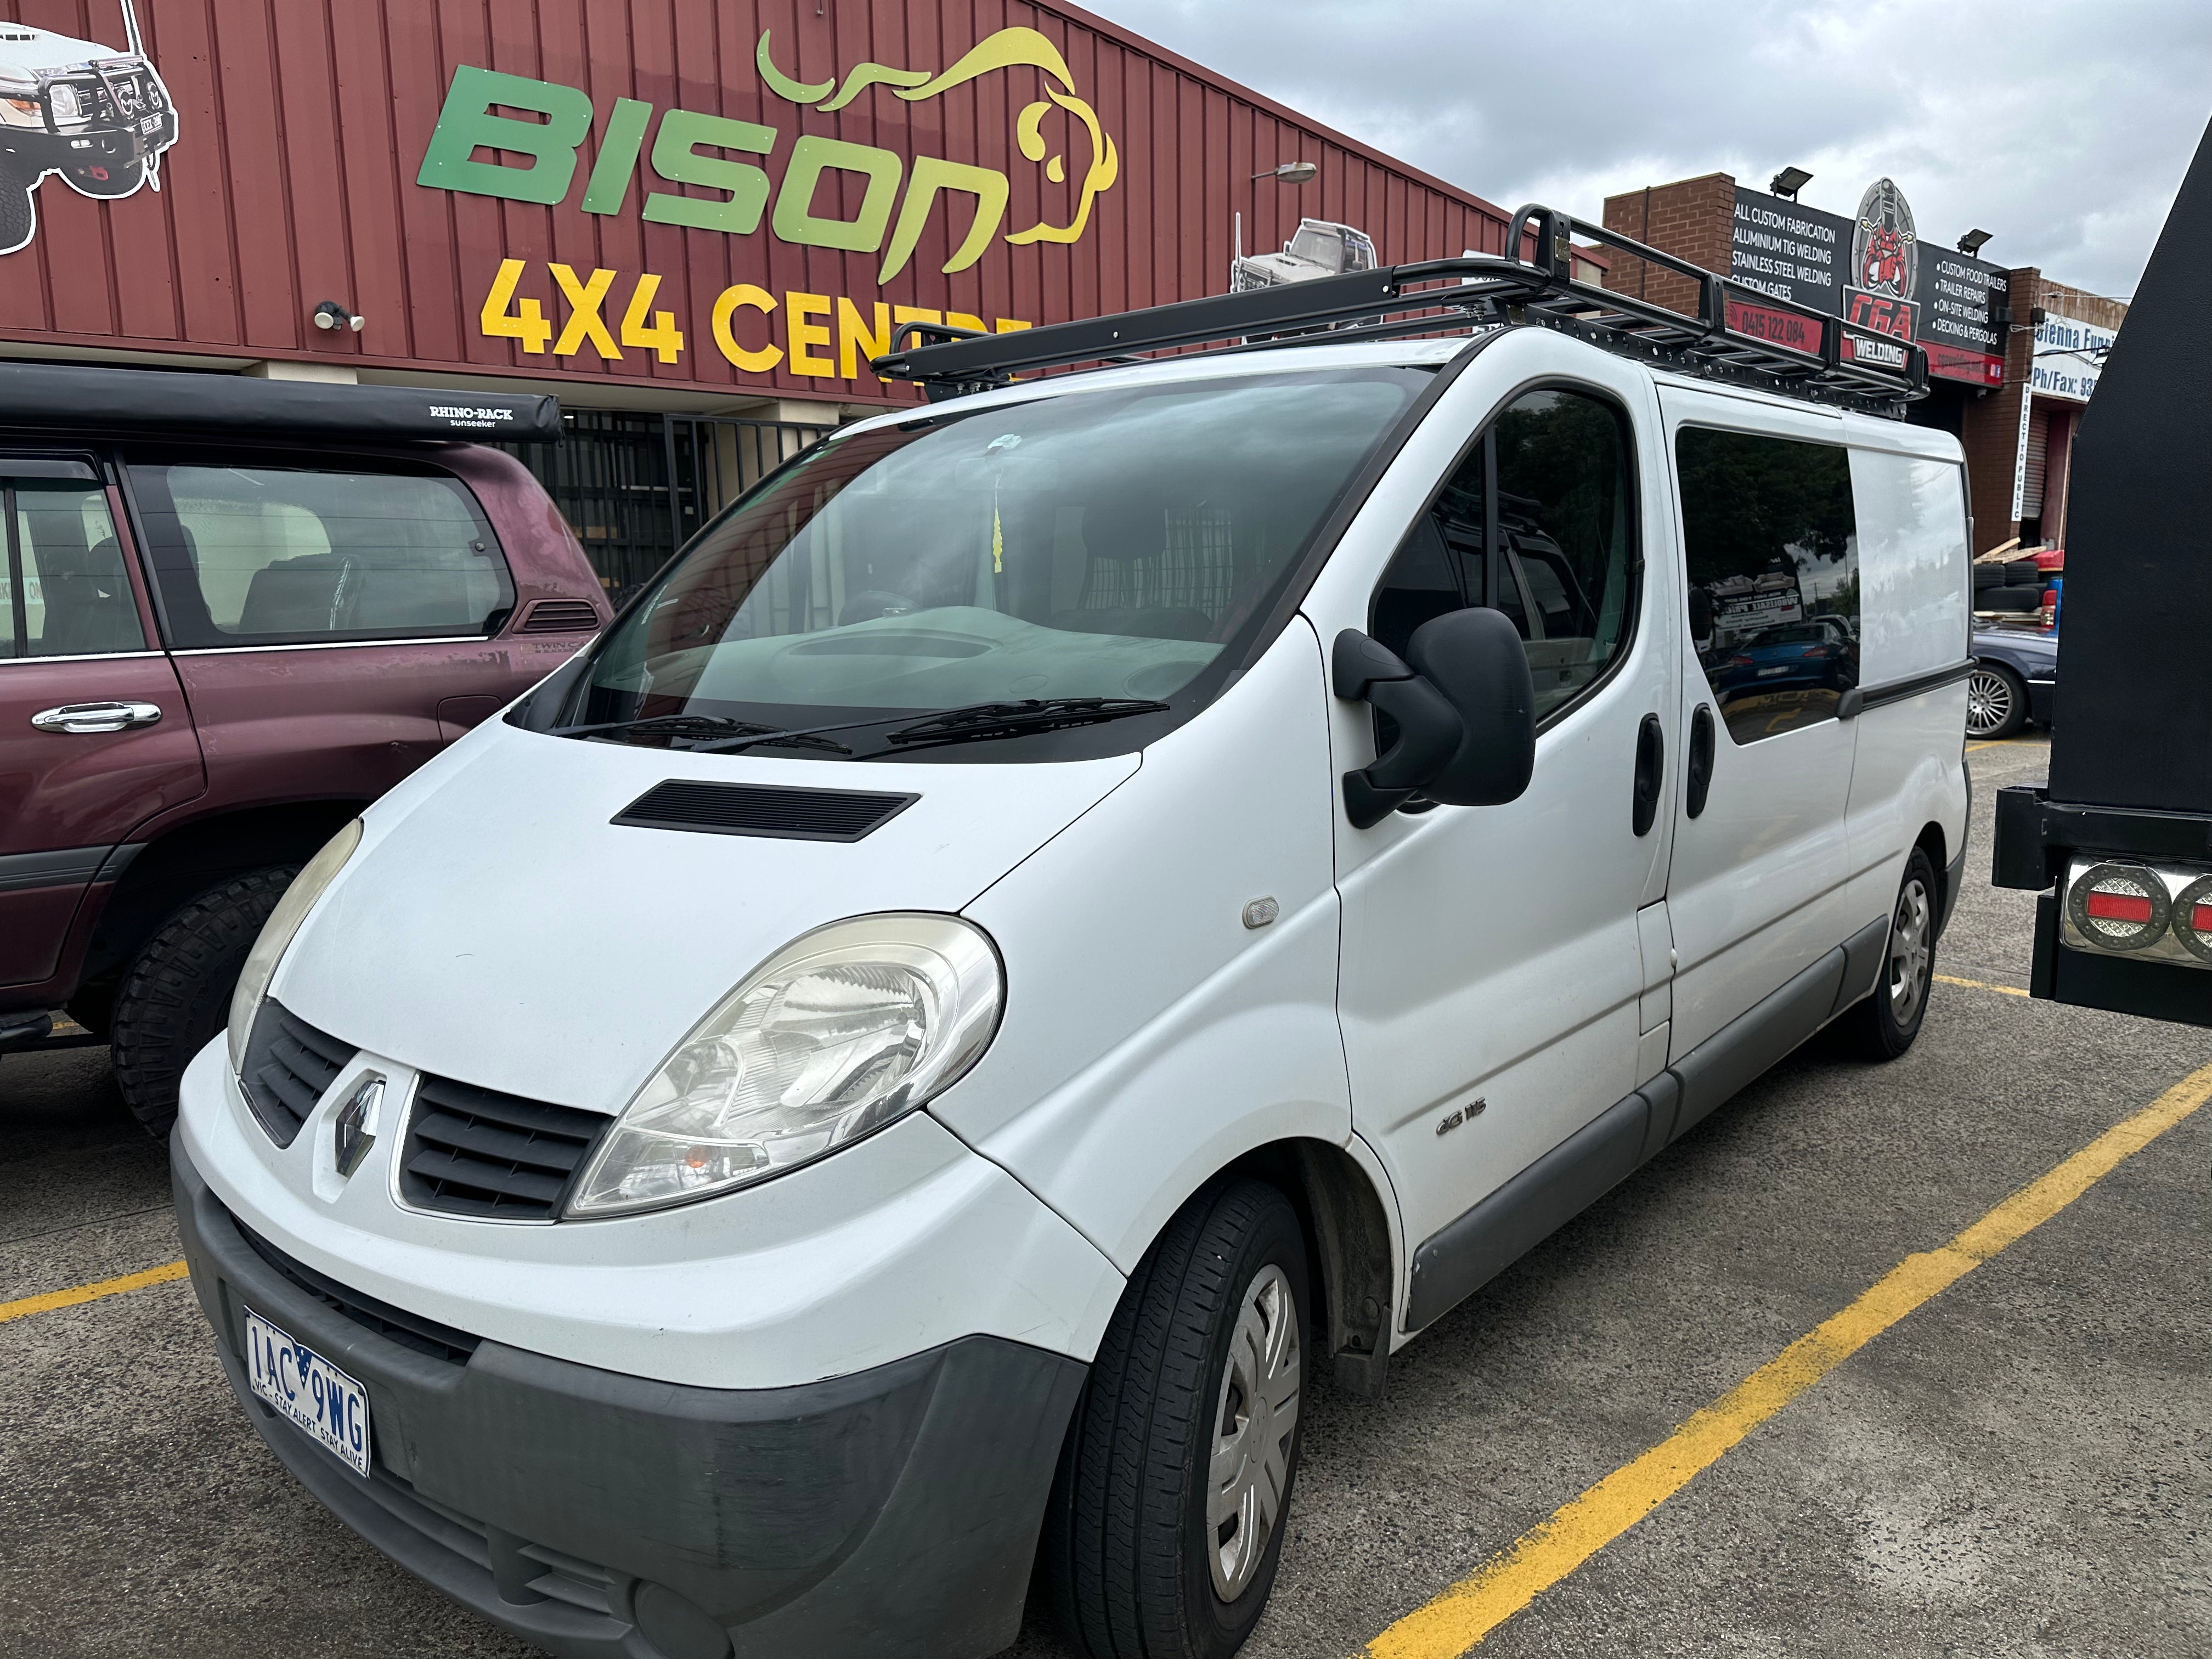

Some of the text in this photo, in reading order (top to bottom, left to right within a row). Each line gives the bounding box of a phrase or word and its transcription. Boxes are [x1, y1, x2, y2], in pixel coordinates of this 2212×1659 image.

[416, 64, 1009, 285] BISON
[1734, 203, 1836, 244] ALL CUSTOM FABRICATION
[1733, 227, 1832, 265] ALUMINIUM TIG WELDING
[1732, 250, 1832, 287] STAINLESS STEEL WELDING
[1941, 260, 2007, 292] CUSTOM FOOD TRAILERS
[1731, 274, 1791, 301] CUSTOM GATES
[1939, 279, 1986, 304] TRAILER REPAIRS
[481, 258, 684, 363] 4X4
[1938, 298, 1989, 324] ON-SITE WELDING
[1741, 311, 1805, 344] 0415 122 084
[1937, 318, 1997, 345] DECKING & PERGOLAS
[1856, 338, 1903, 364] WELDING
[2033, 367, 2098, 396] Ph/Fax: 93
[430, 405, 513, 420] RHINO-RACK
[450, 420, 496, 428] sunseeker
[2014, 386, 2030, 518] DIRECT TO PUBLIC
[1465, 1097, 1486, 1121] 115
[252, 1325, 362, 1452] 1AC 9WG
[255, 1379, 267, 1397] VIC
[275, 1393, 291, 1416] STAY
[293, 1409, 316, 1434] ALERT
[320, 1427, 338, 1452] STAY
[341, 1444, 363, 1470] ALIVE
